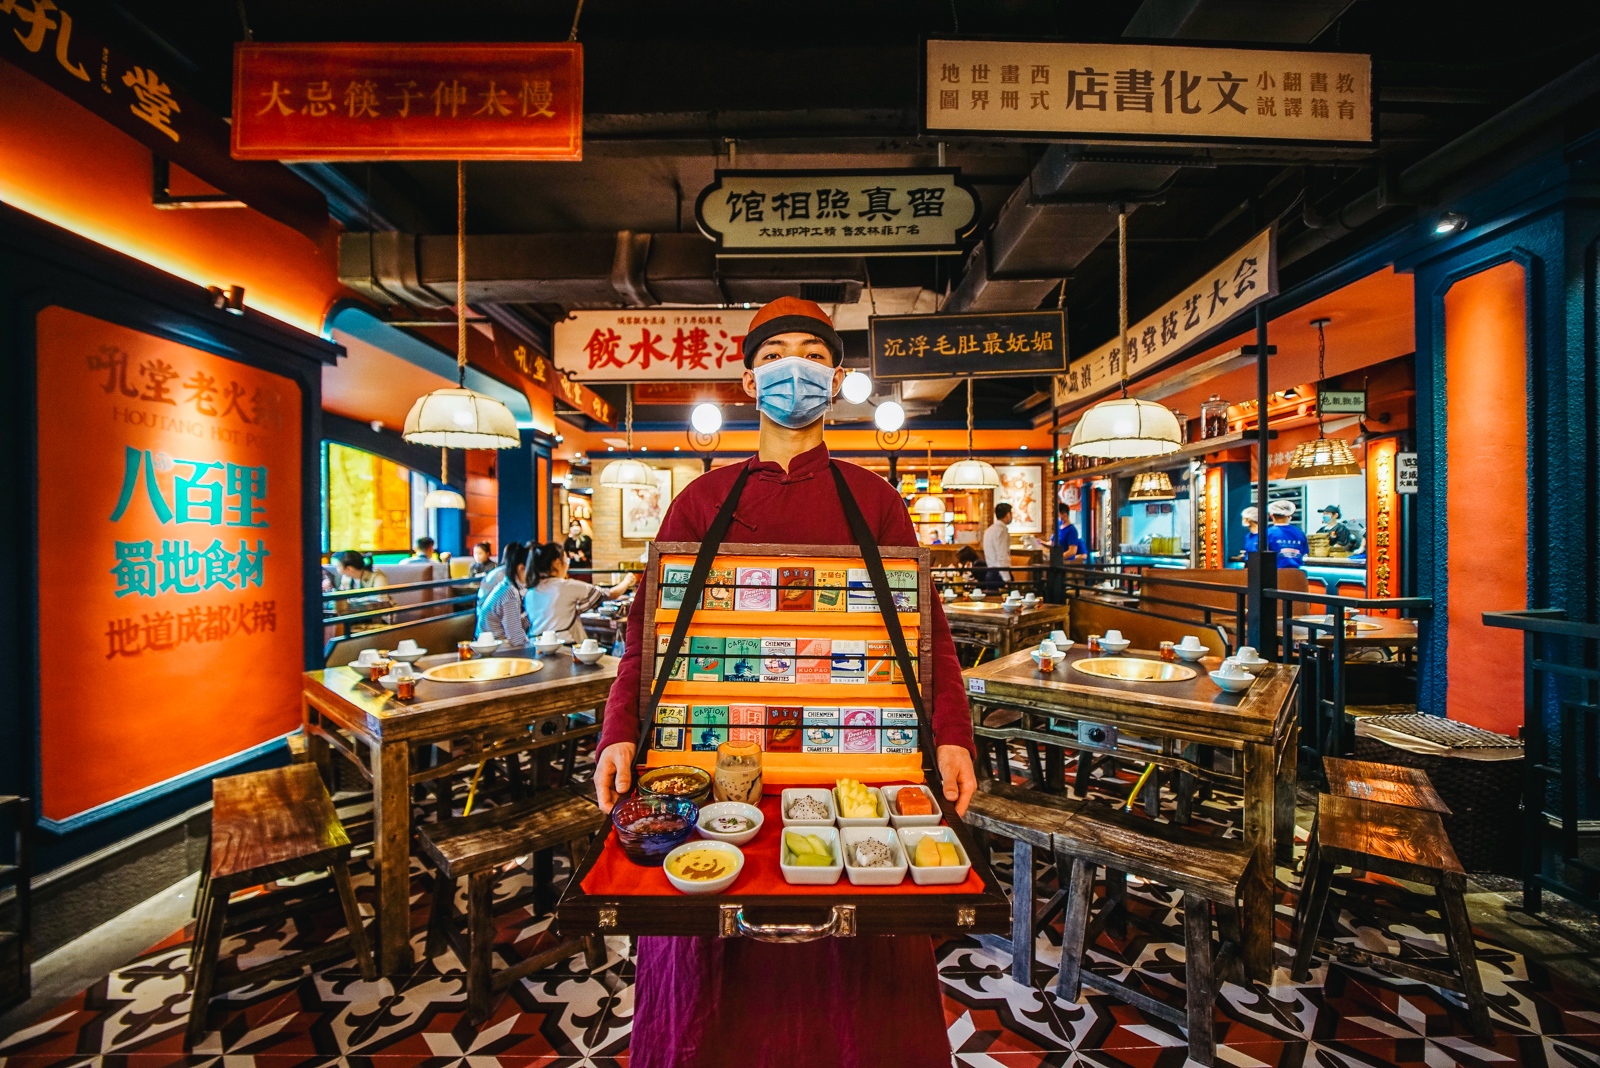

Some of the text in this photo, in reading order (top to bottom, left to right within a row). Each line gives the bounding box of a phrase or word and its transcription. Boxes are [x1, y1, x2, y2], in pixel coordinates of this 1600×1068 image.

[255, 79, 556, 118] 大忌筷子伸太慢
[883, 330, 1053, 357] 沉浮毛肚最妩媚
[113, 406, 203, 438] HOUTANG
[109, 445, 270, 528] 八百里
[108, 538, 271, 599] 蜀地食材
[886, 570, 915, 580] CAPTION
[105, 600, 277, 660] 地道成都火锅
[727, 639, 759, 650] CAPTION
[693, 707, 726, 717] CAPTION
